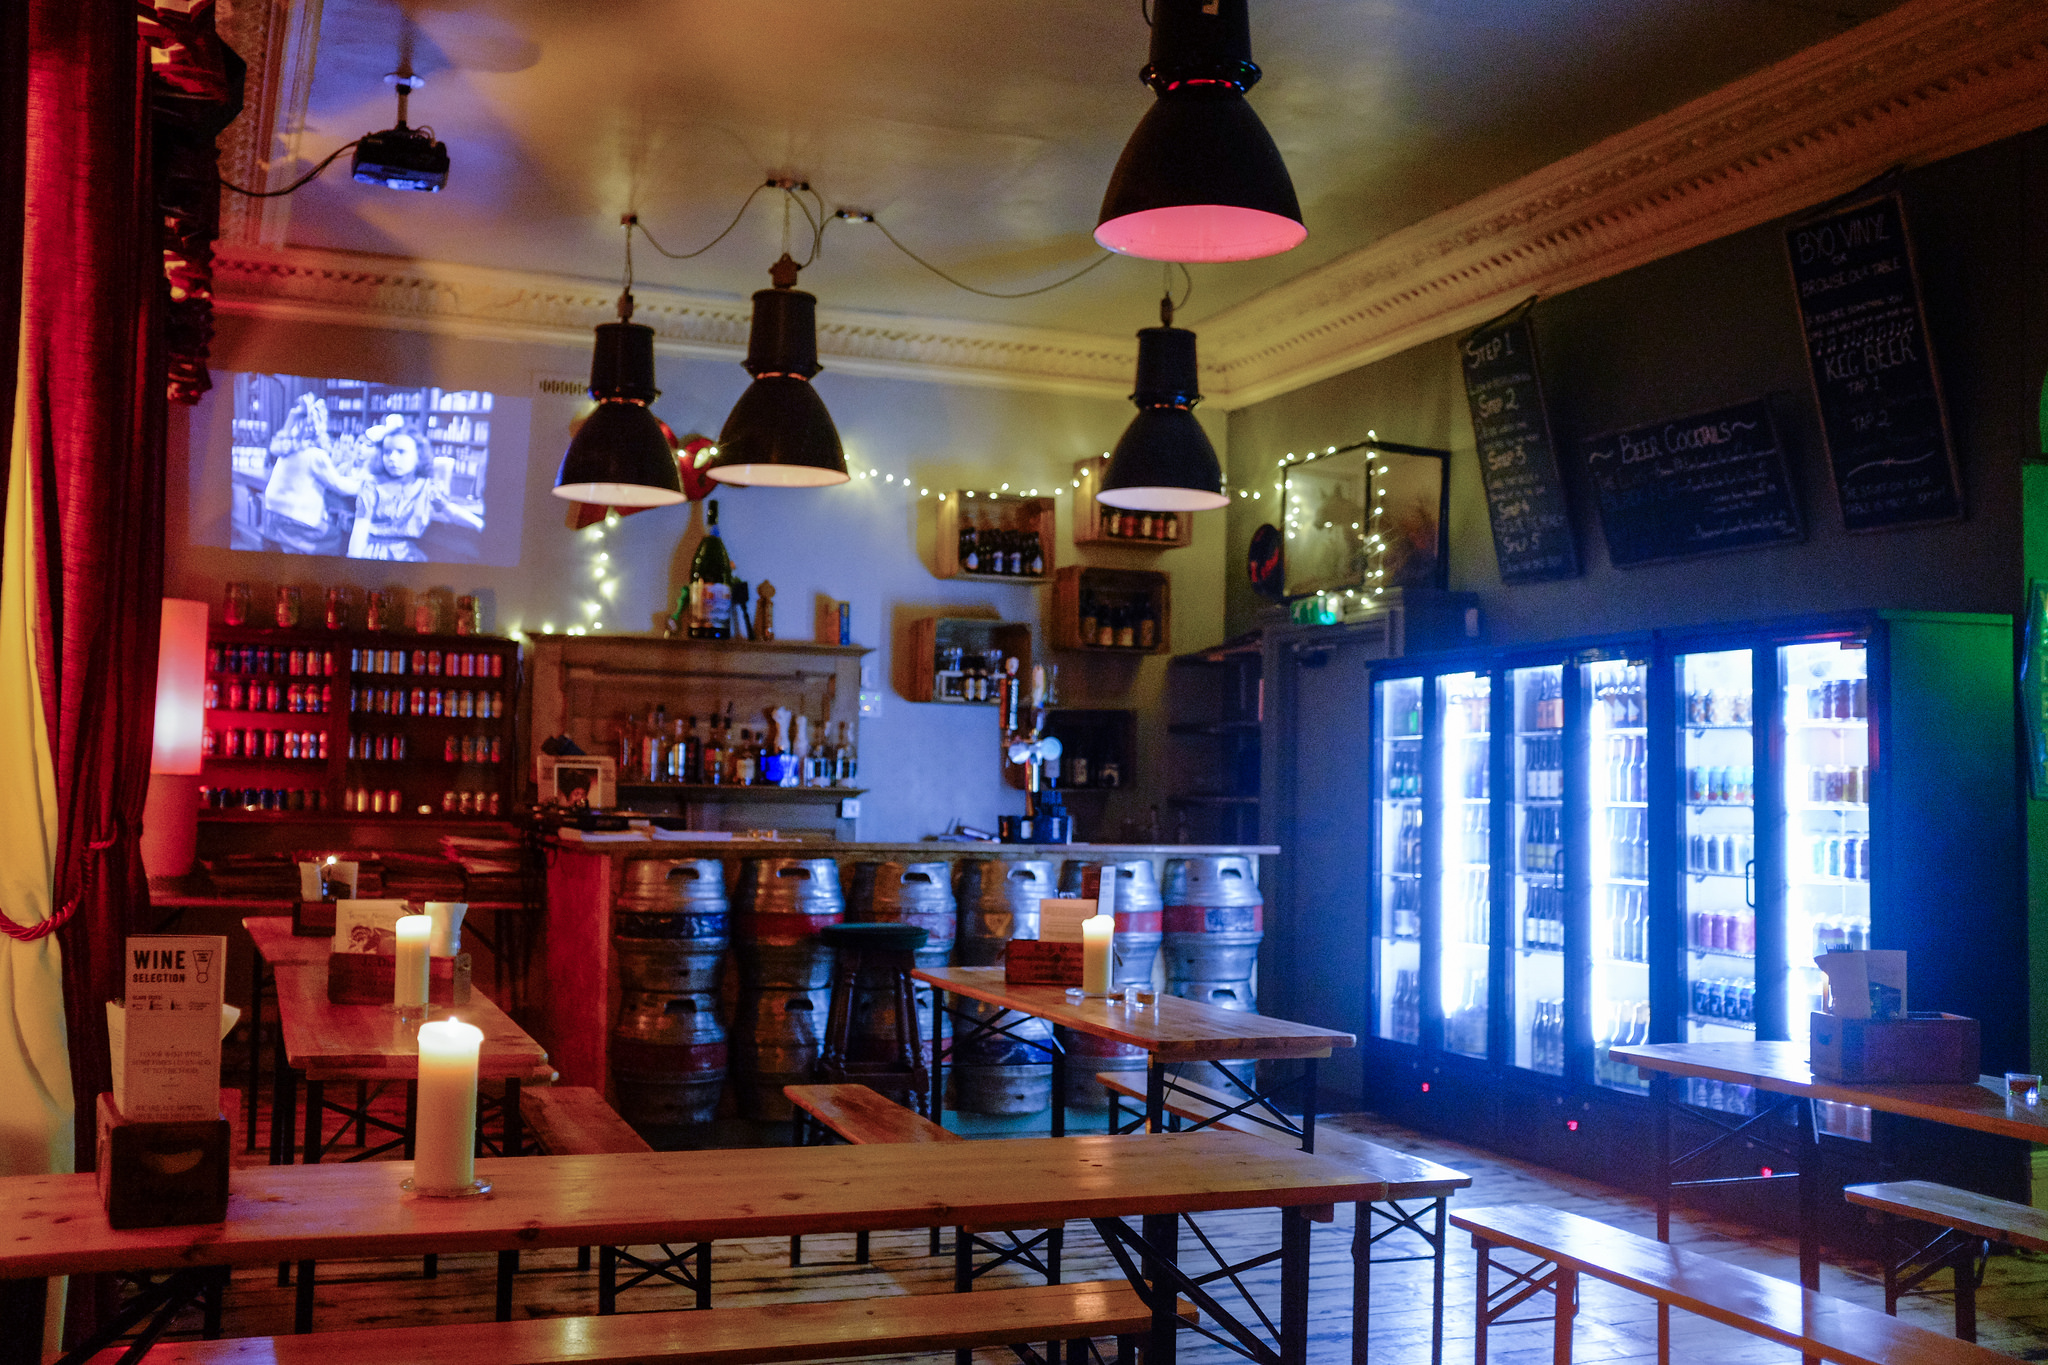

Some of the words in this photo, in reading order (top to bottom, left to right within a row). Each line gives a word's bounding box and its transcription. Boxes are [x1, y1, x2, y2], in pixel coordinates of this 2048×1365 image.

[1796, 225, 1836, 265] BYO
[1837, 213, 1891, 249] VINYL
[1466, 337, 1502, 369] STEP
[1504, 331, 1514, 356] 1
[1824, 350, 1860, 382] KEG
[1863, 334, 1918, 374] BEER
[1505, 387, 1520, 411] 2
[1877, 409, 1893, 428] 2
[1619, 434, 1663, 465] BEER
[133, 950, 186, 970] WINE
[132, 973, 186, 984] SELECTION
